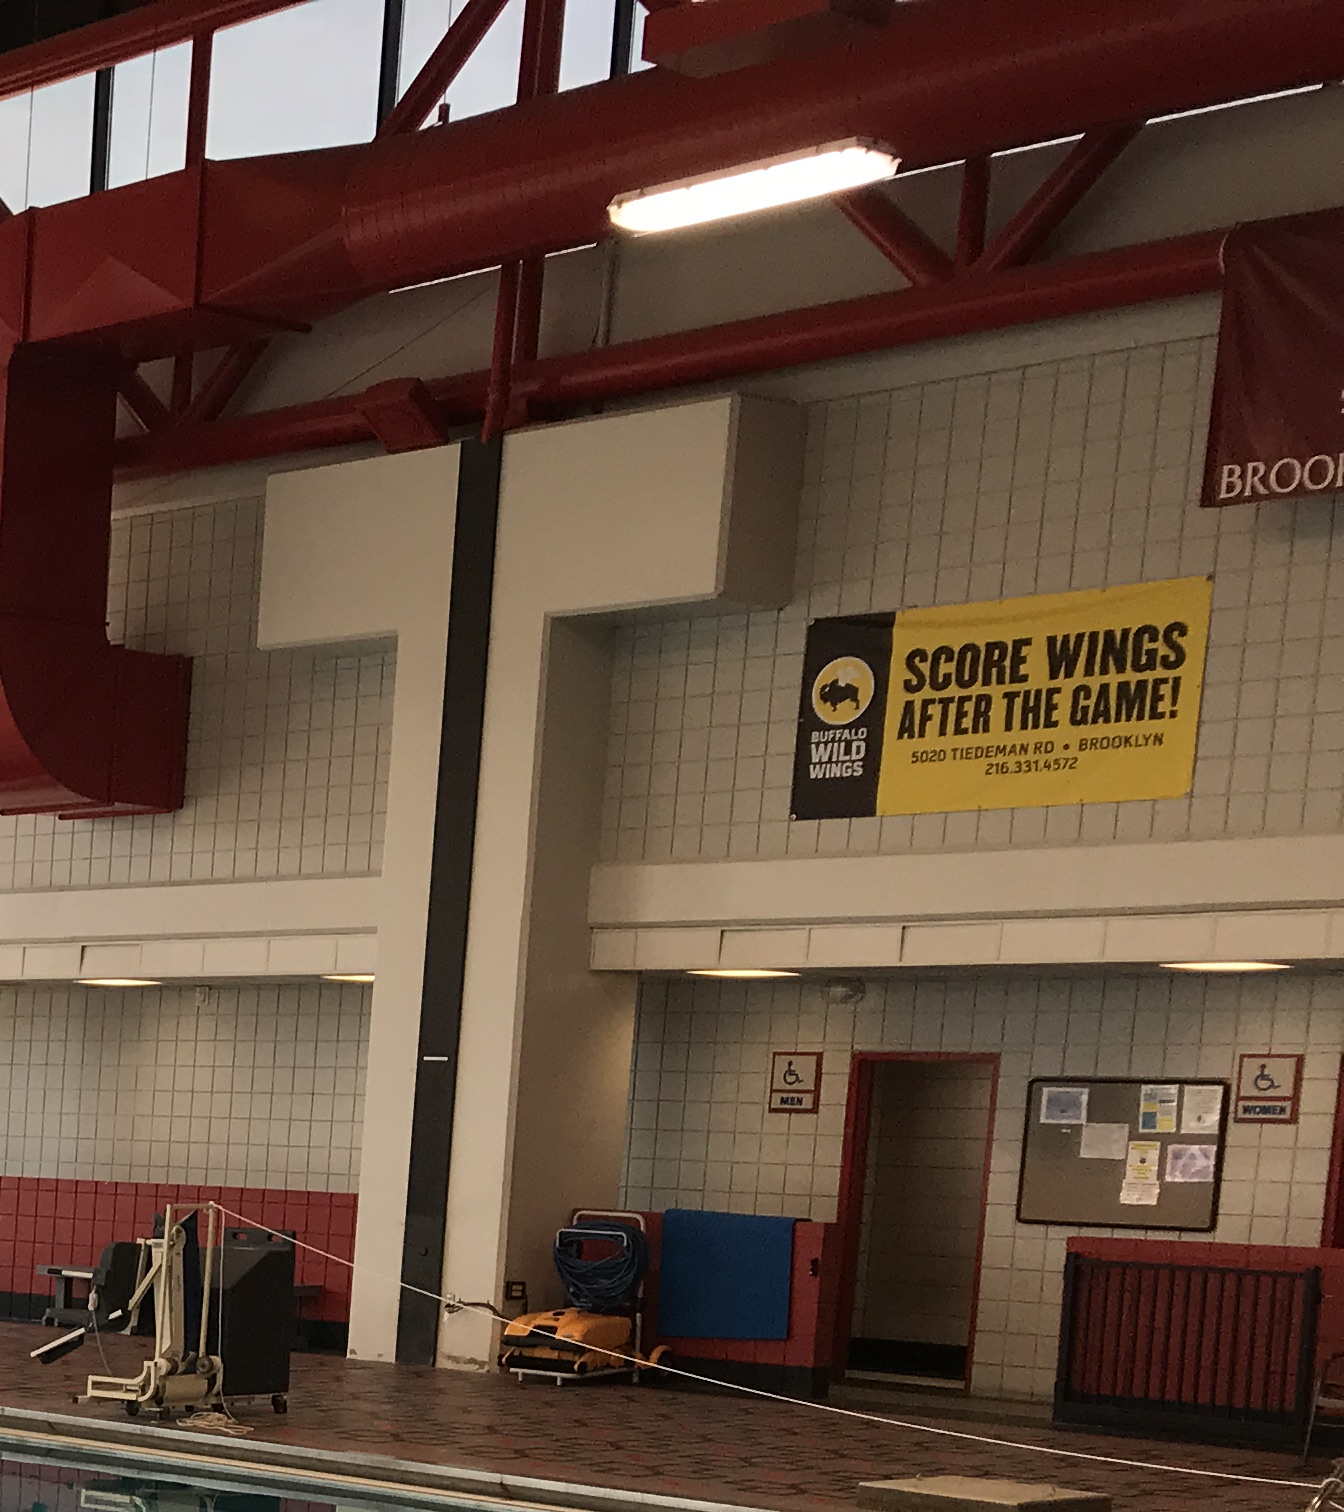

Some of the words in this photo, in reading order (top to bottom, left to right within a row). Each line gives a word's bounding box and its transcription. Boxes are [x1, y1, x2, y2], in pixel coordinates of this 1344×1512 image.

[903, 637, 1032, 694] SCORE
[1046, 621, 1189, 681] WINGS
[896, 693, 992, 741] AFTER
[1002, 687, 1062, 732] THE
[1069, 675, 1182, 727] GAME!
[811, 727, 868, 743] BUFFALO
[811, 740, 866, 763] WILD
[911, 749, 947, 764] 5020
[951, 742, 1029, 761] TIEDEMAN
[1033, 740, 1055, 755] RD
[1078, 732, 1165, 752] BROOKLYN
[809, 761, 864, 779] WINGS
[984, 757, 1079, 776] 216.331.4572
[780, 1096, 803, 1106] MEN
[1241, 1105, 1286, 1115] WOMEN
